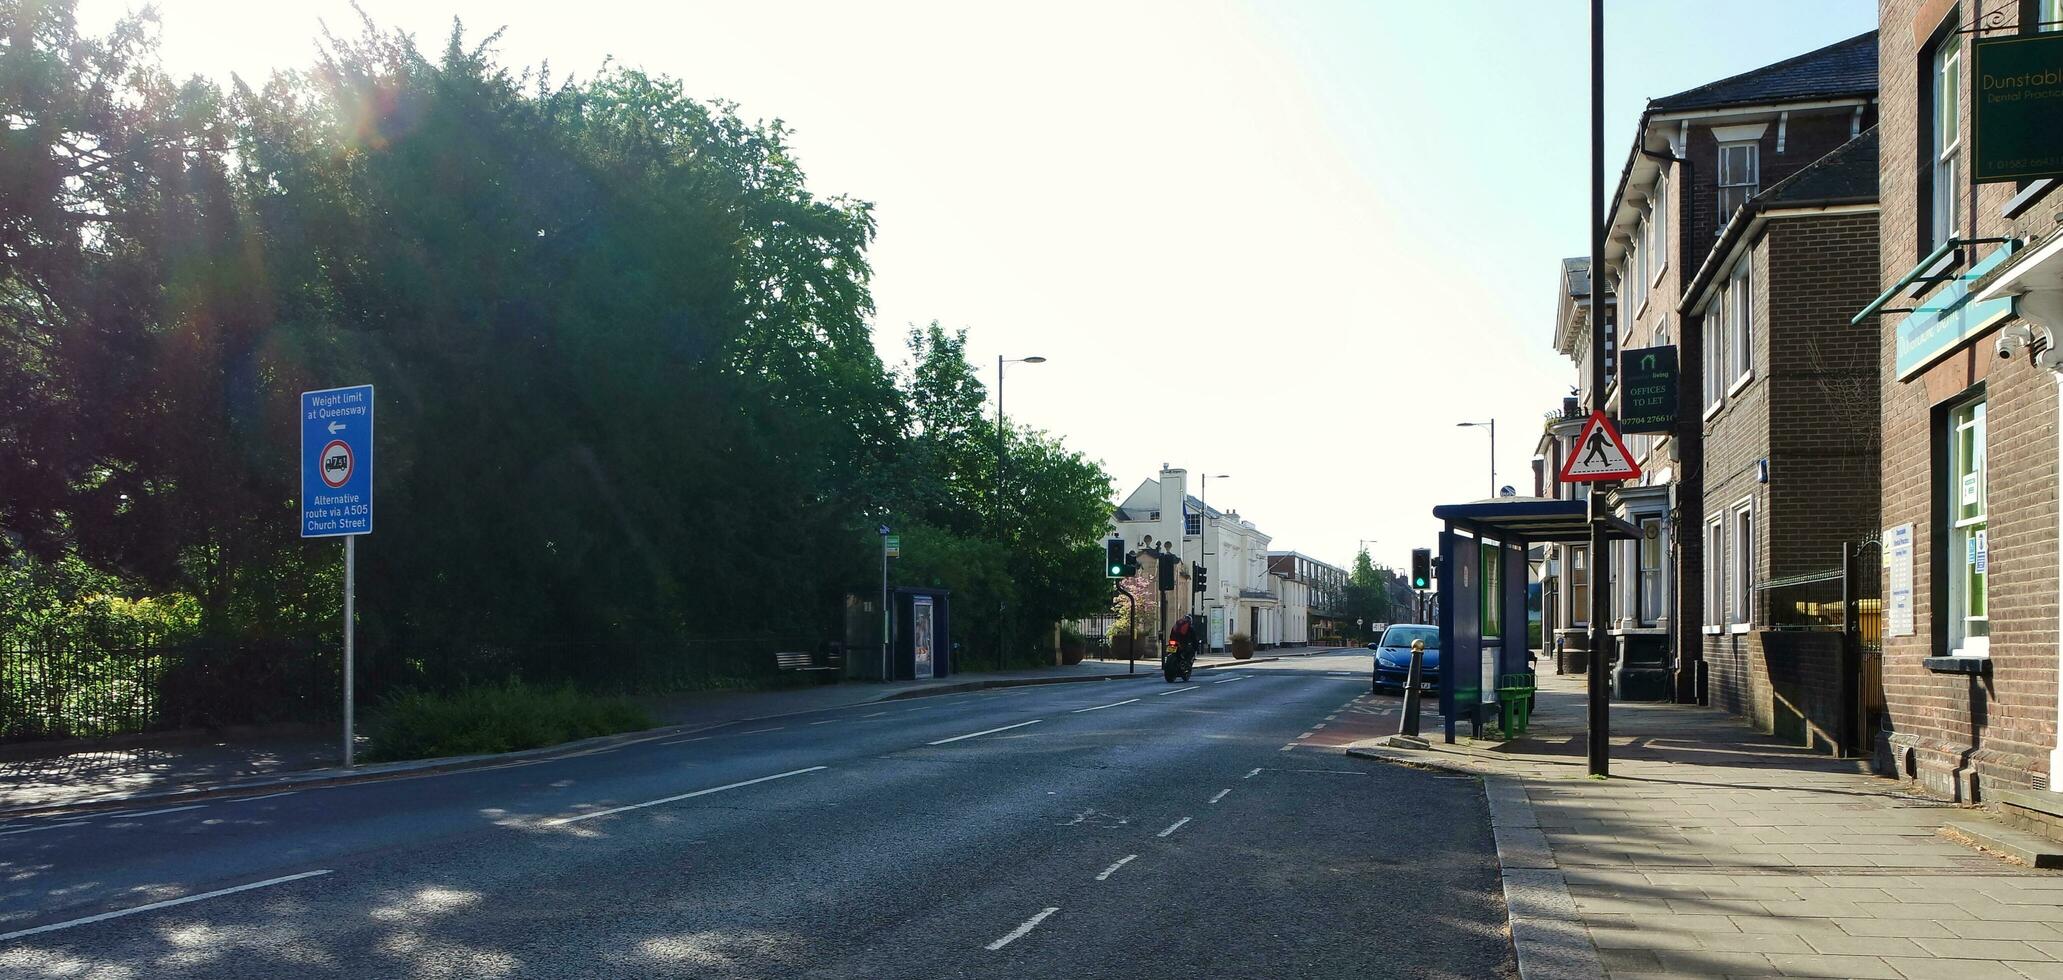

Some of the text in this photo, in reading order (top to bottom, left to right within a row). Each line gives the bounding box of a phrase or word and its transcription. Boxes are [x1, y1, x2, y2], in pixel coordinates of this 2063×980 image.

[1983, 67, 2063, 90] Dunstabl
[1630, 385, 1666, 396] OFFICES
[312, 391, 363, 407] Weight limit
[1633, 397, 1664, 407] TO LET
[307, 405, 367, 420] at Queensway
[1621, 417, 1645, 425] 07704
[314, 494, 360, 506] Alternative
[305, 509, 328, 519] route
[329, 506, 341, 517] via
[308, 517, 366, 531] Church Street
